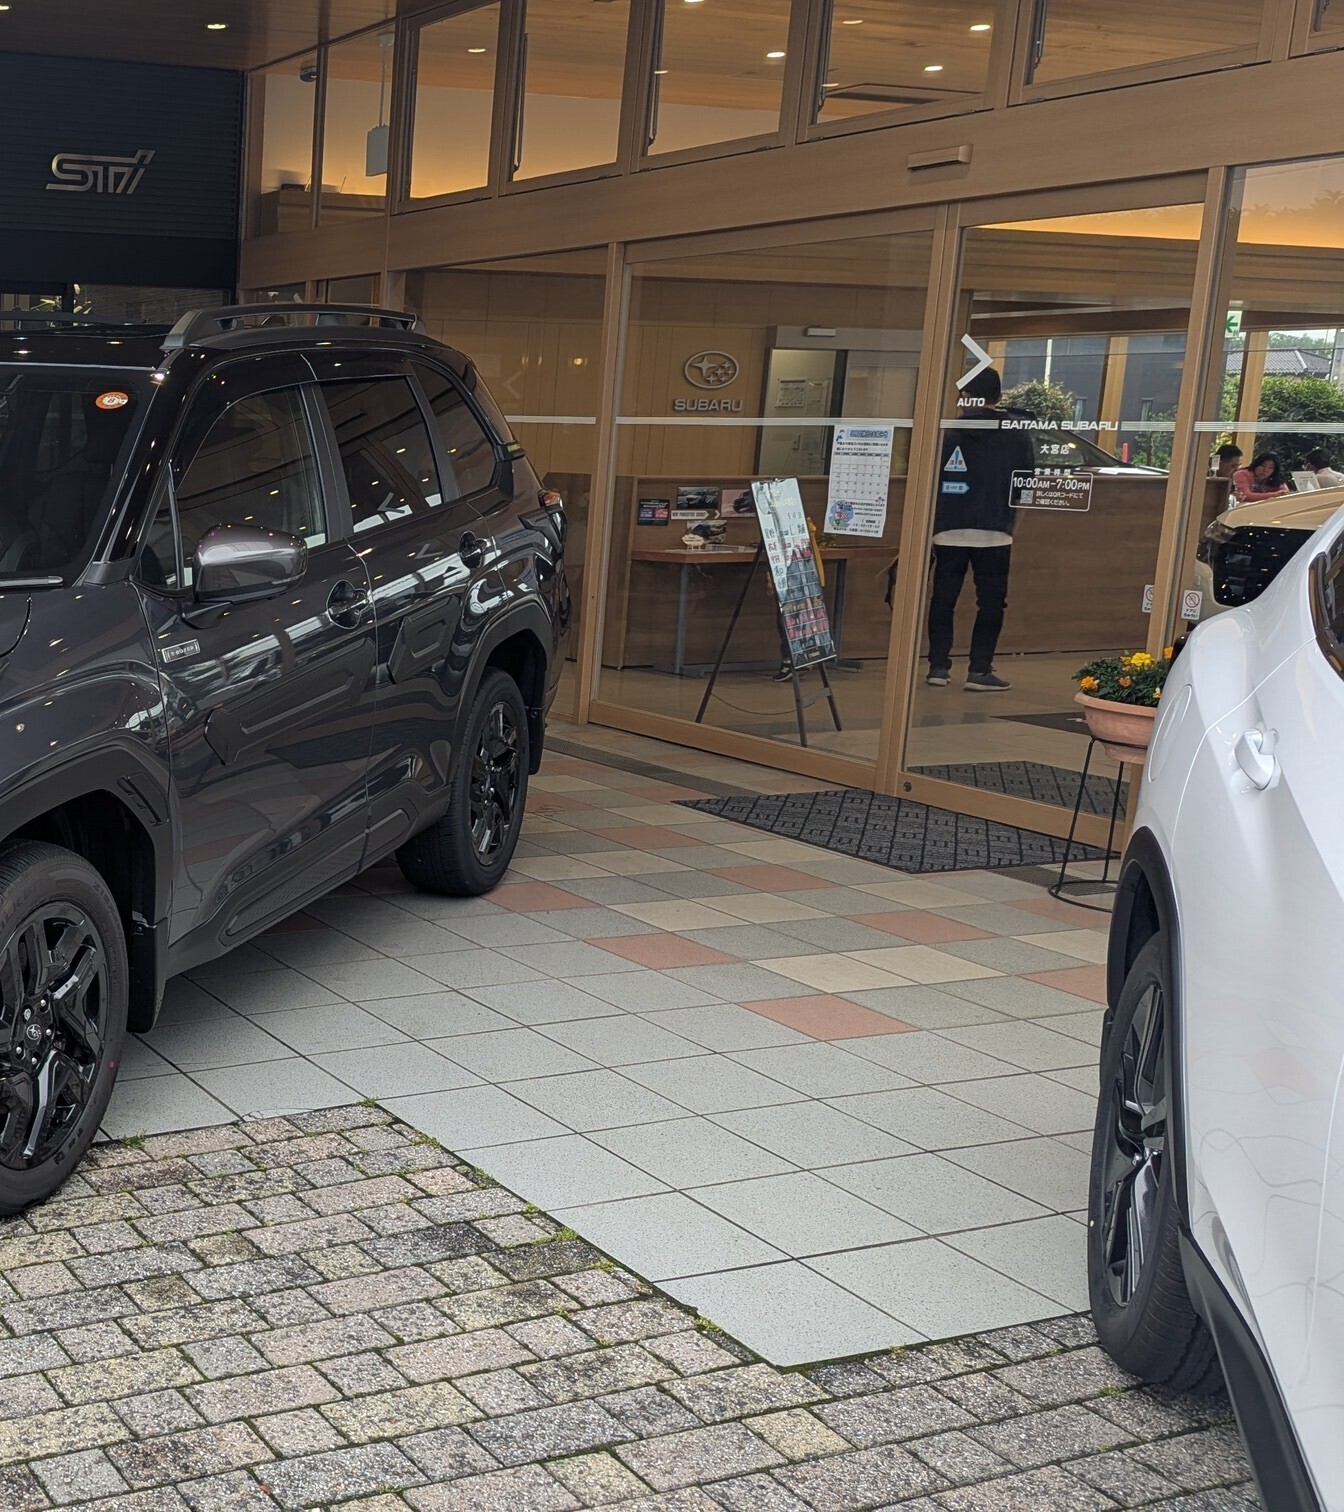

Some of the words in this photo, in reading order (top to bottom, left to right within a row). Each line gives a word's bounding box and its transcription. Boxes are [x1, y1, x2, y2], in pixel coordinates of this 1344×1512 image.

[674, 398, 743, 411] SUBARU
[957, 397, 986, 407] AUTO
[1001, 420, 1058, 430] SAITAMA
[1061, 421, 1119, 431] SUBARU
[1040, 443, 1070, 455] 大宮店
